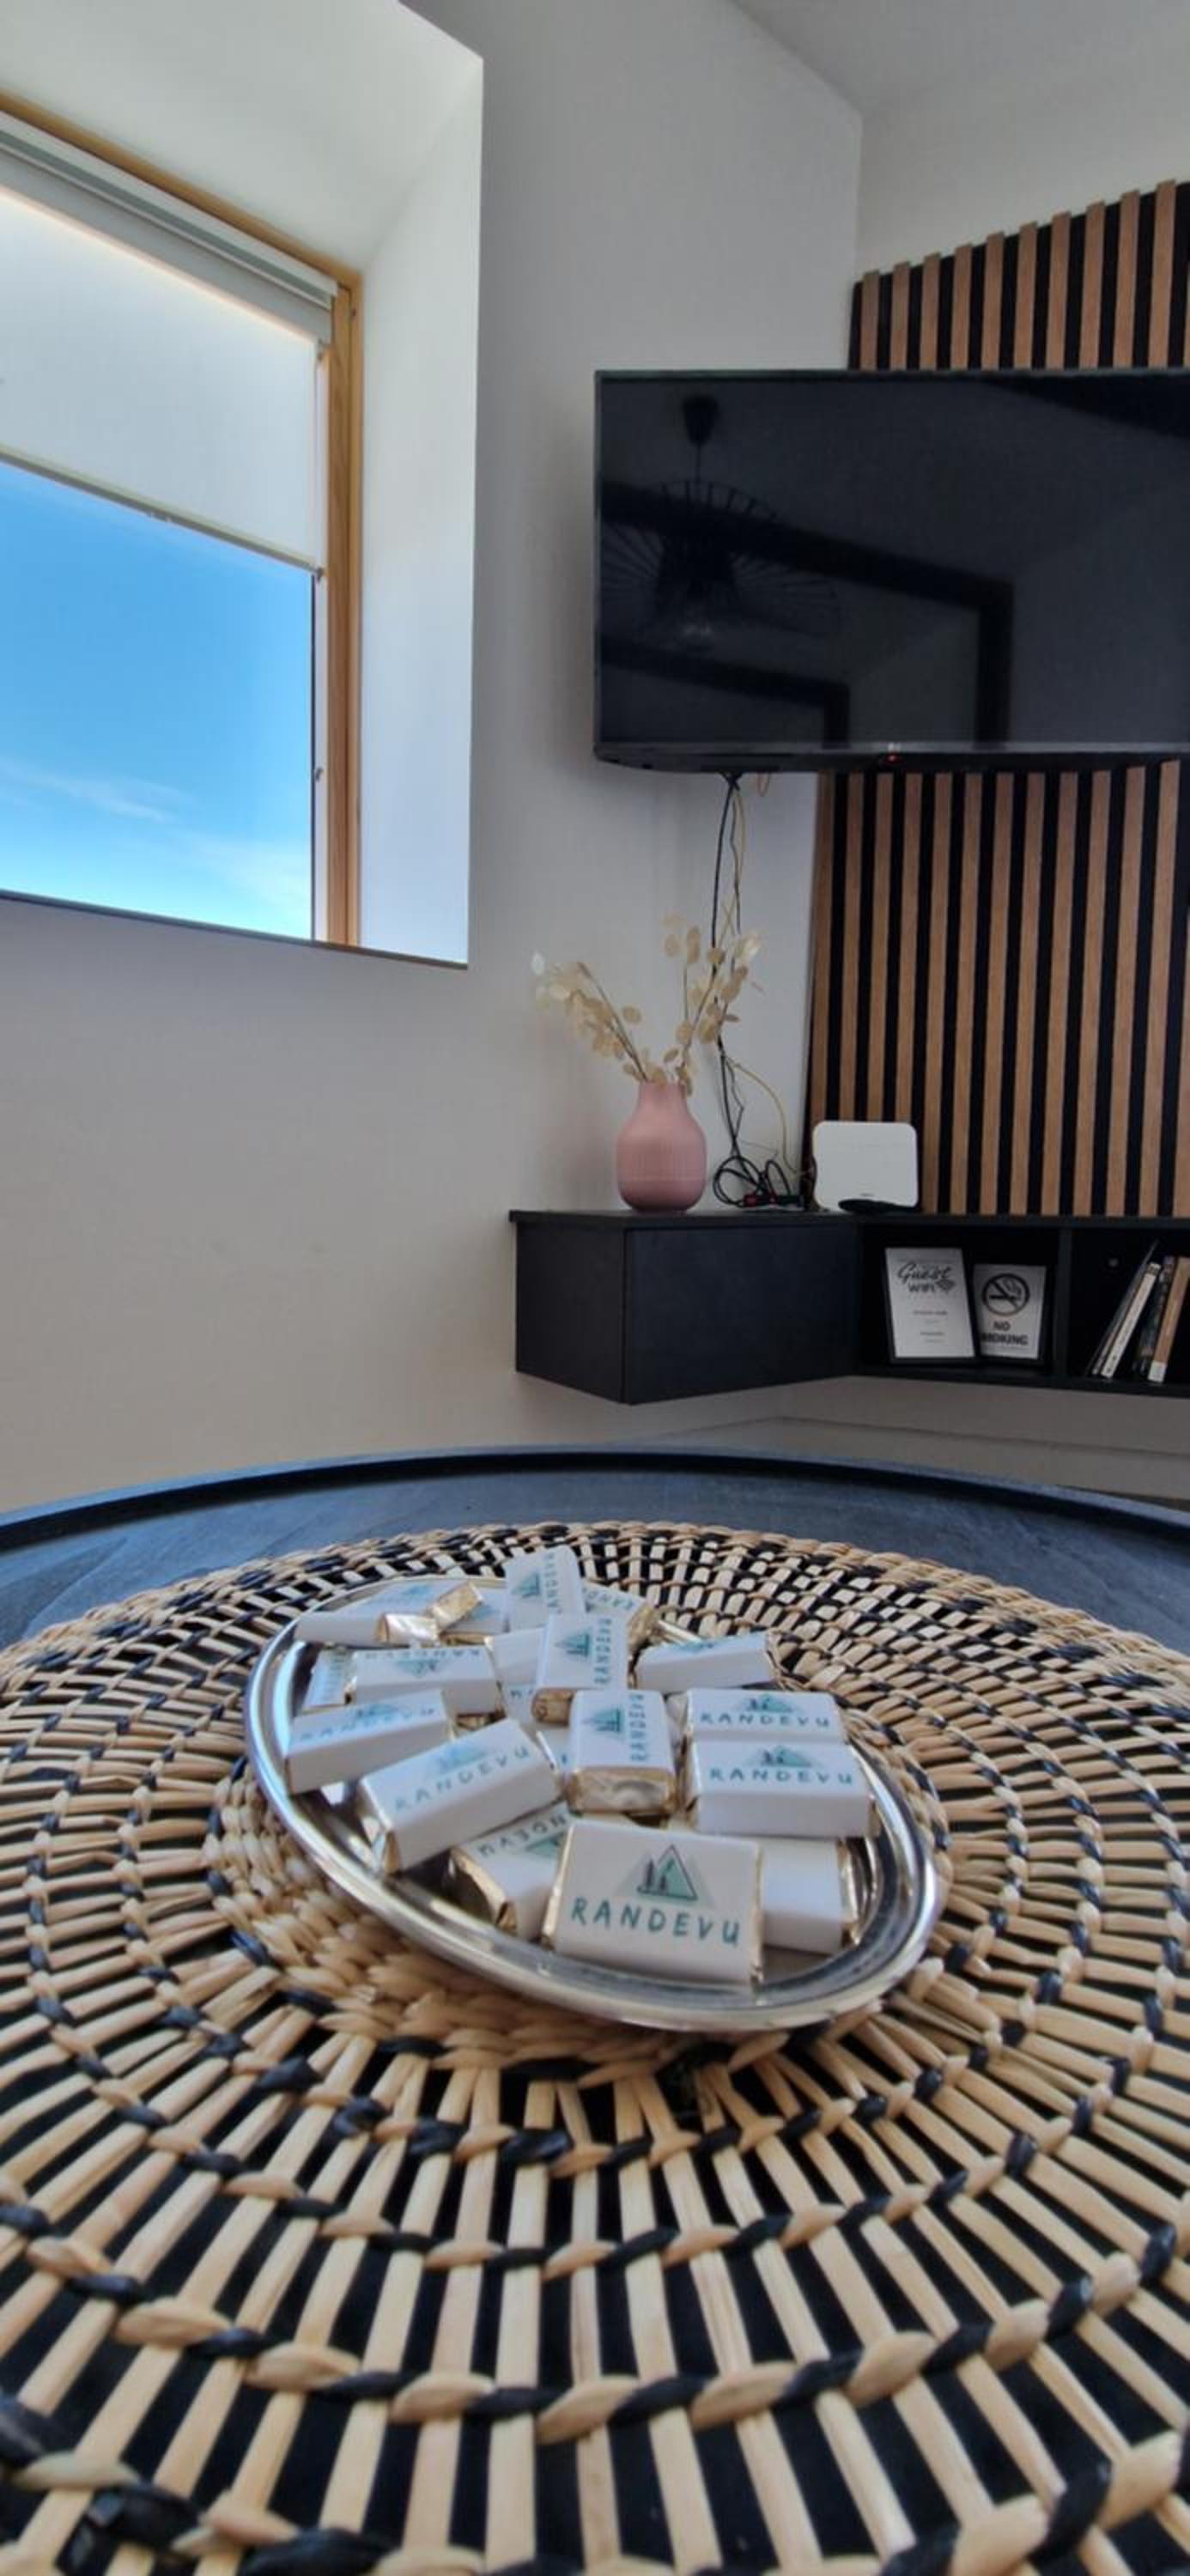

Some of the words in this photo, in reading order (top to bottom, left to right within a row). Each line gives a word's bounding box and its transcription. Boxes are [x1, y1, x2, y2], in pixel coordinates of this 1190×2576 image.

[897, 1261, 952, 1285] Guest
[993, 1321, 1011, 1331] NO
[628, 1694, 649, 1761] RANDEVU
[700, 1712, 830, 1727] RANDEVU
[396, 1746, 529, 1812] RANDEVU
[709, 1767, 853, 1785] RANDEVU
[477, 1814, 567, 1857] NDEVU
[572, 1896, 740, 1946] RANDEVU
